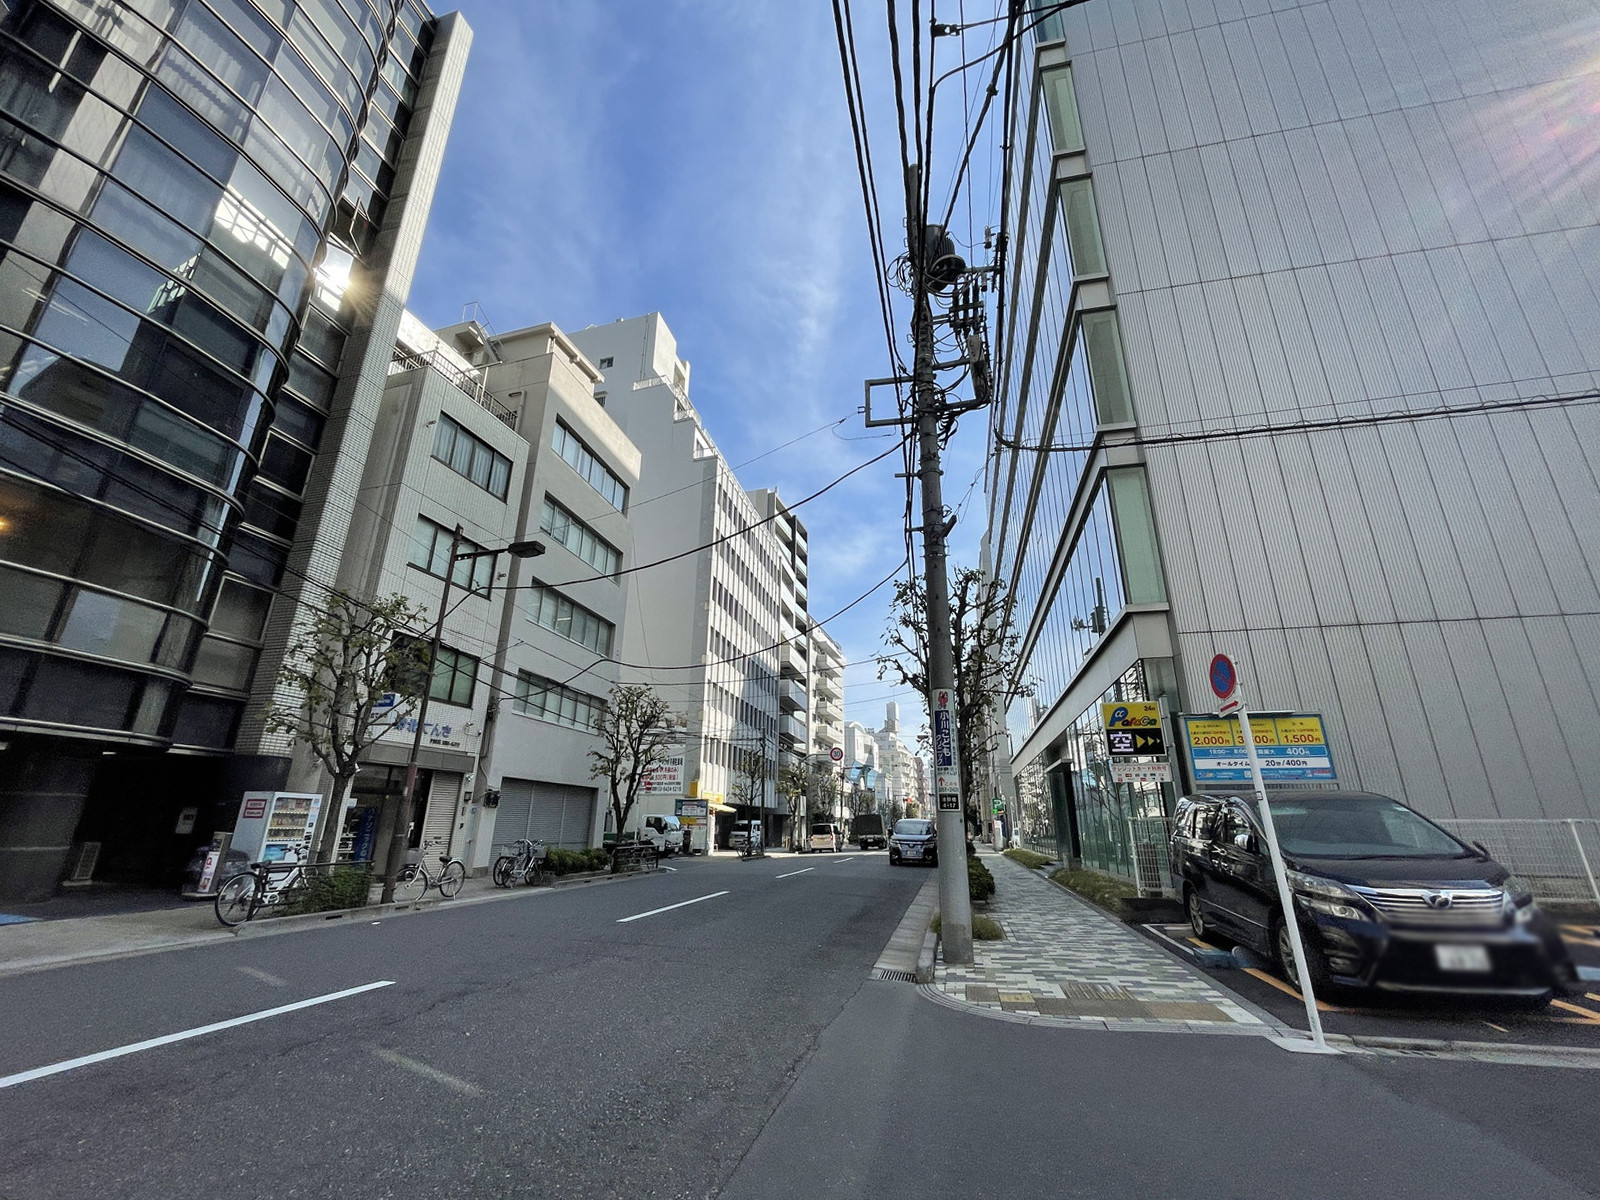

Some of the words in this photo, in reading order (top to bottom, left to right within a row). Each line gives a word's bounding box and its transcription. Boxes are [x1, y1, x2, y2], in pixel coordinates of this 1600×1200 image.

[940, 711, 951, 757] 小川こども
[1284, 734, 1320, 743] 1,500円
[1110, 731, 1134, 752] 空
[1194, 735, 1231, 745] 2,000円
[1286, 747, 1310, 755] 400円
